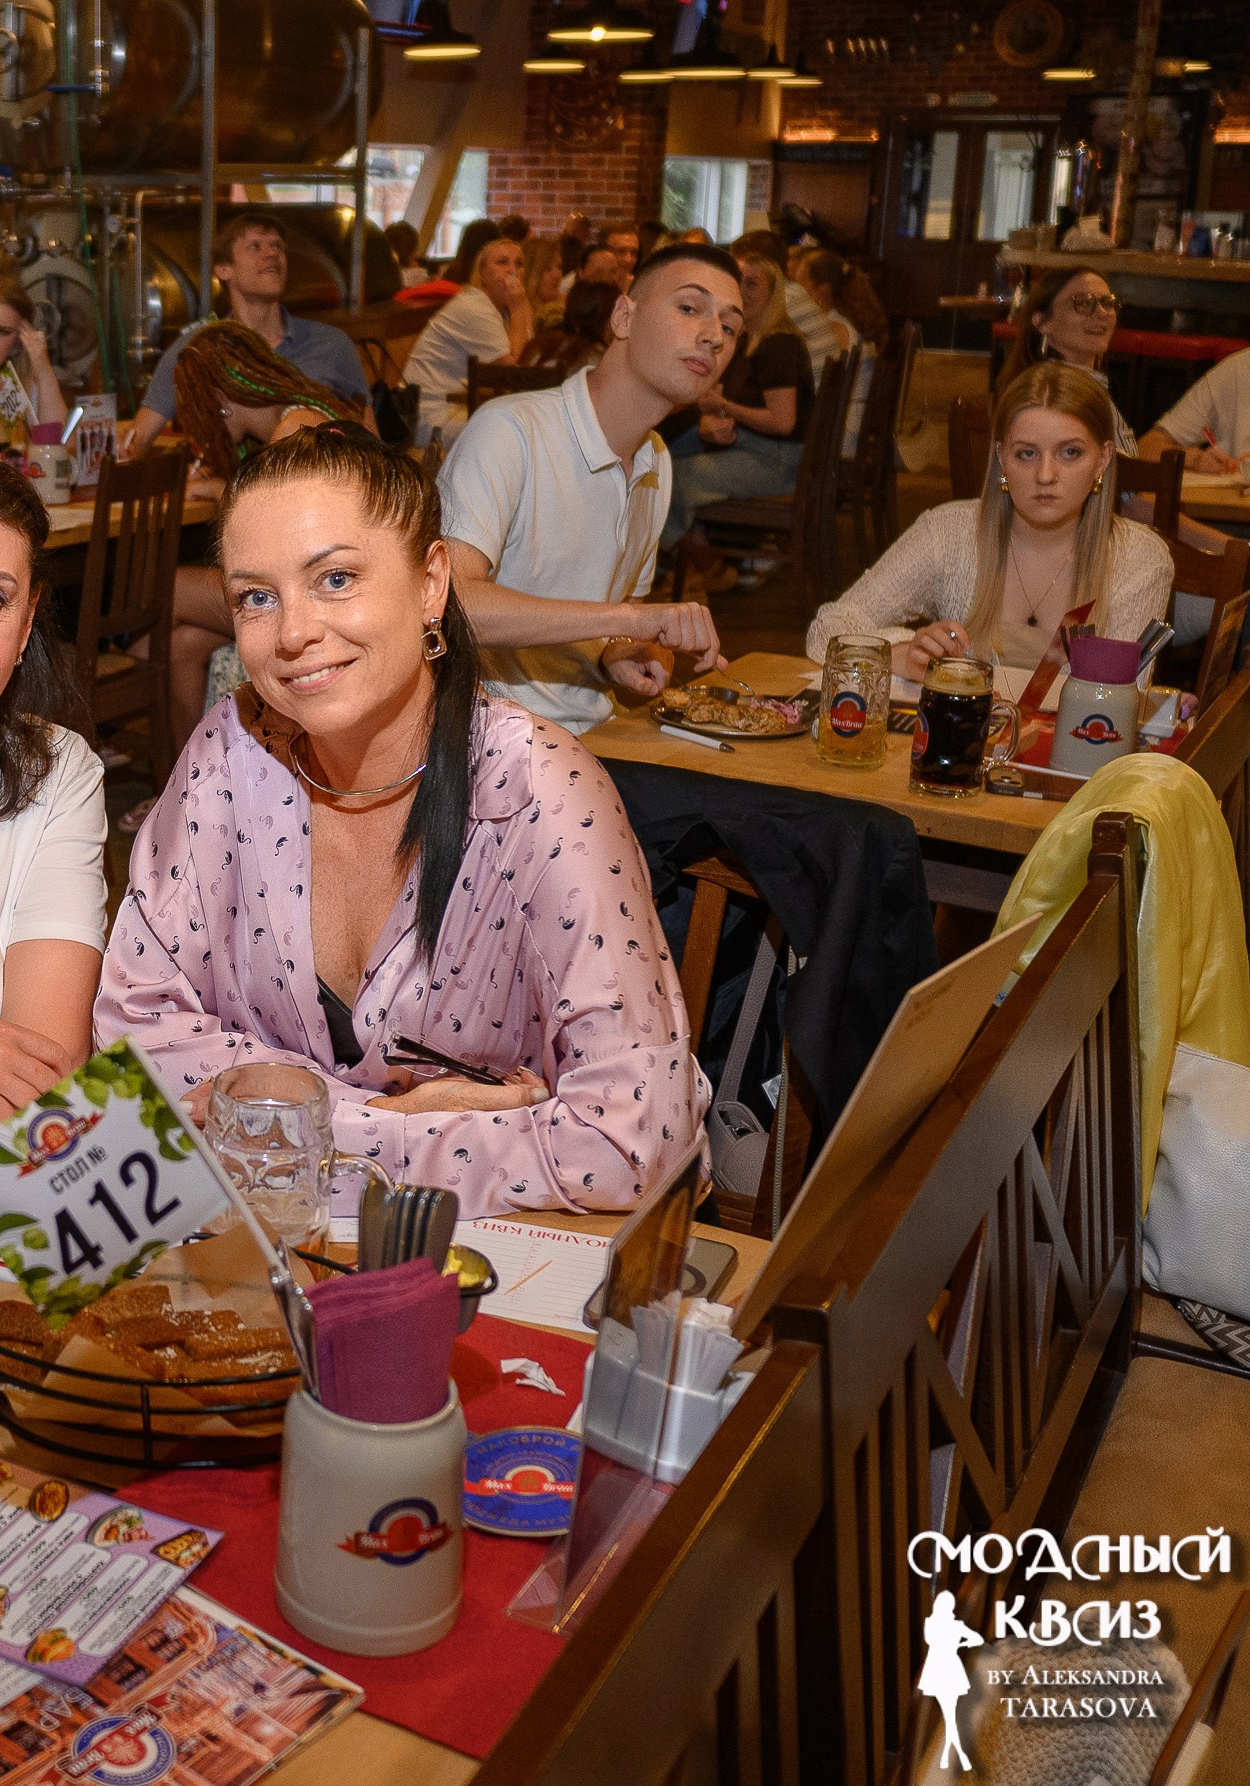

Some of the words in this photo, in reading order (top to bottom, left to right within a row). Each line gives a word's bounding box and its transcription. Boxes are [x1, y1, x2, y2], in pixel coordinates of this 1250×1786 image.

[49, 1156, 91, 1196] СТОЛ
[86, 1143, 108, 1166] №
[55, 1149, 182, 1277] 412
[471, 1220, 522, 1235] КВИЗ
[39, 1685, 94, 1733] БАР
